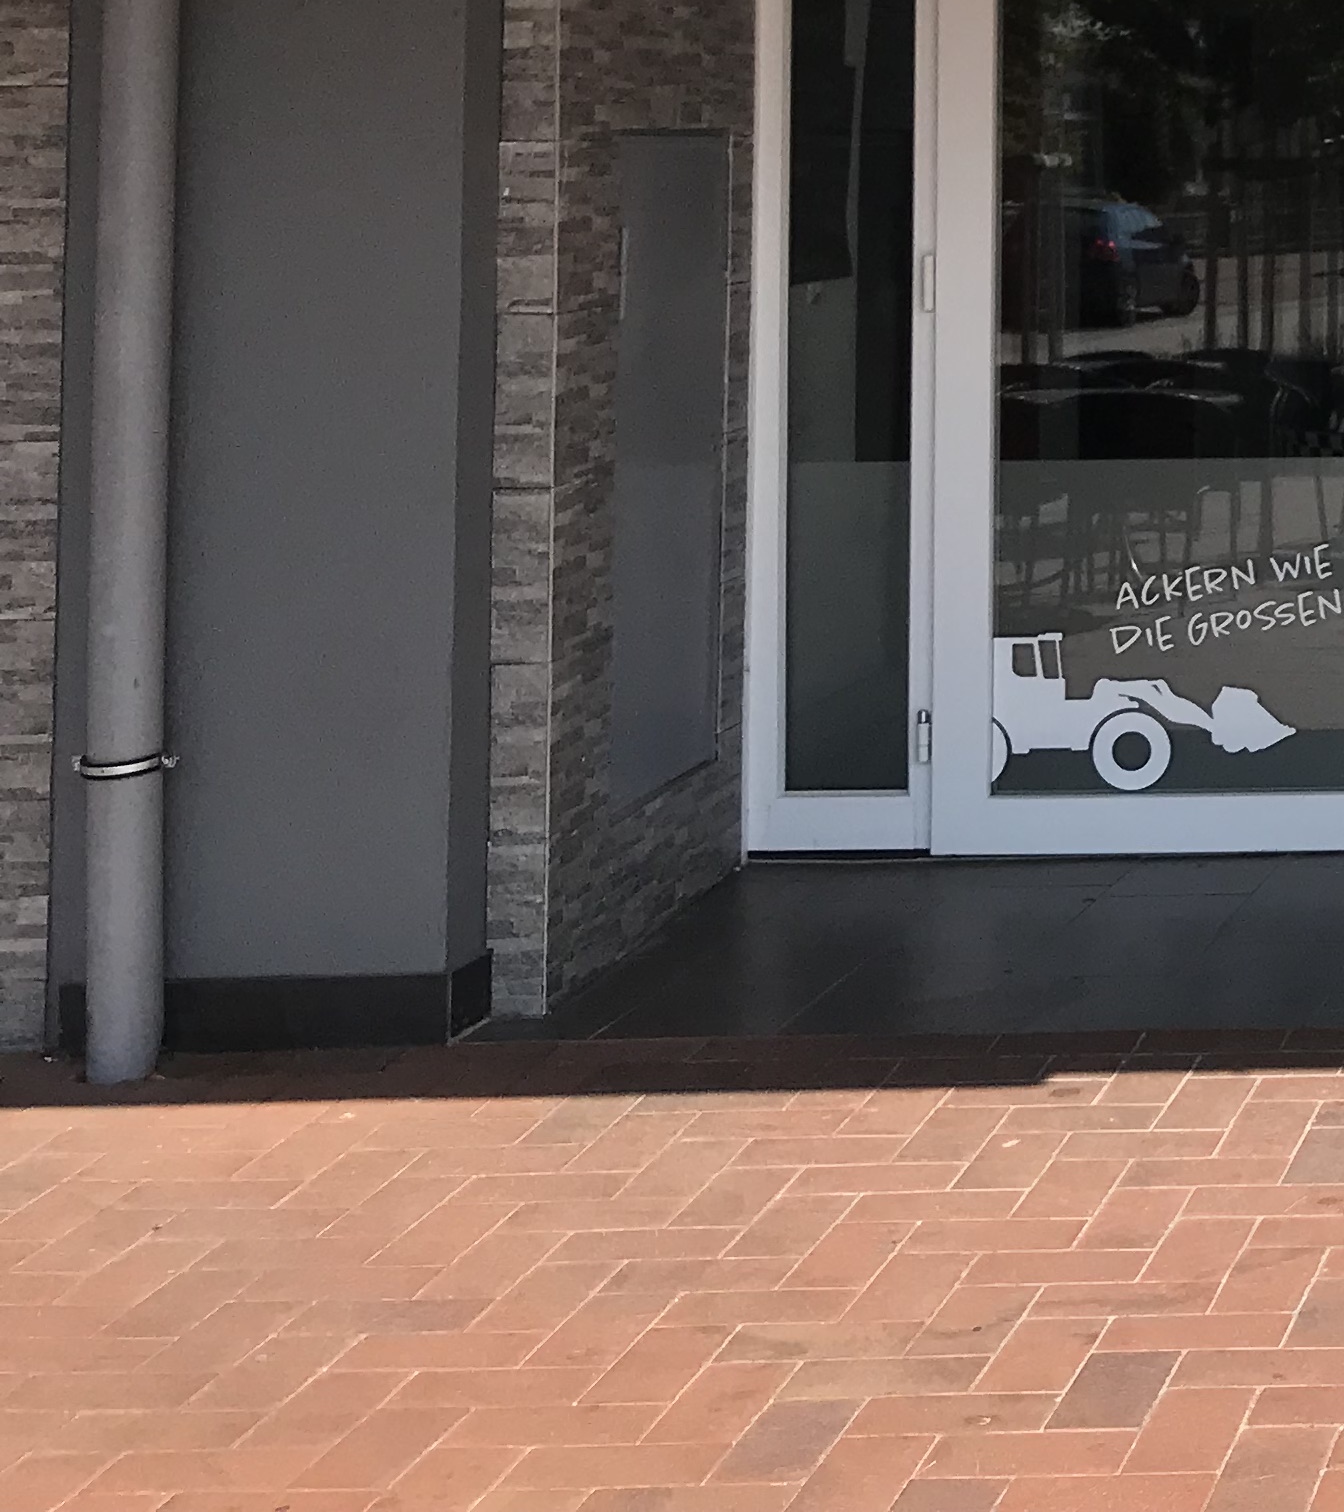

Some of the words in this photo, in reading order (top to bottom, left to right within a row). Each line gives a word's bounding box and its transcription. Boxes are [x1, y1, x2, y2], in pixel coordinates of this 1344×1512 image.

[1115, 557, 1255, 611] ACKERN
[1269, 543, 1334, 583] WIE
[1109, 615, 1175, 654] DIE
